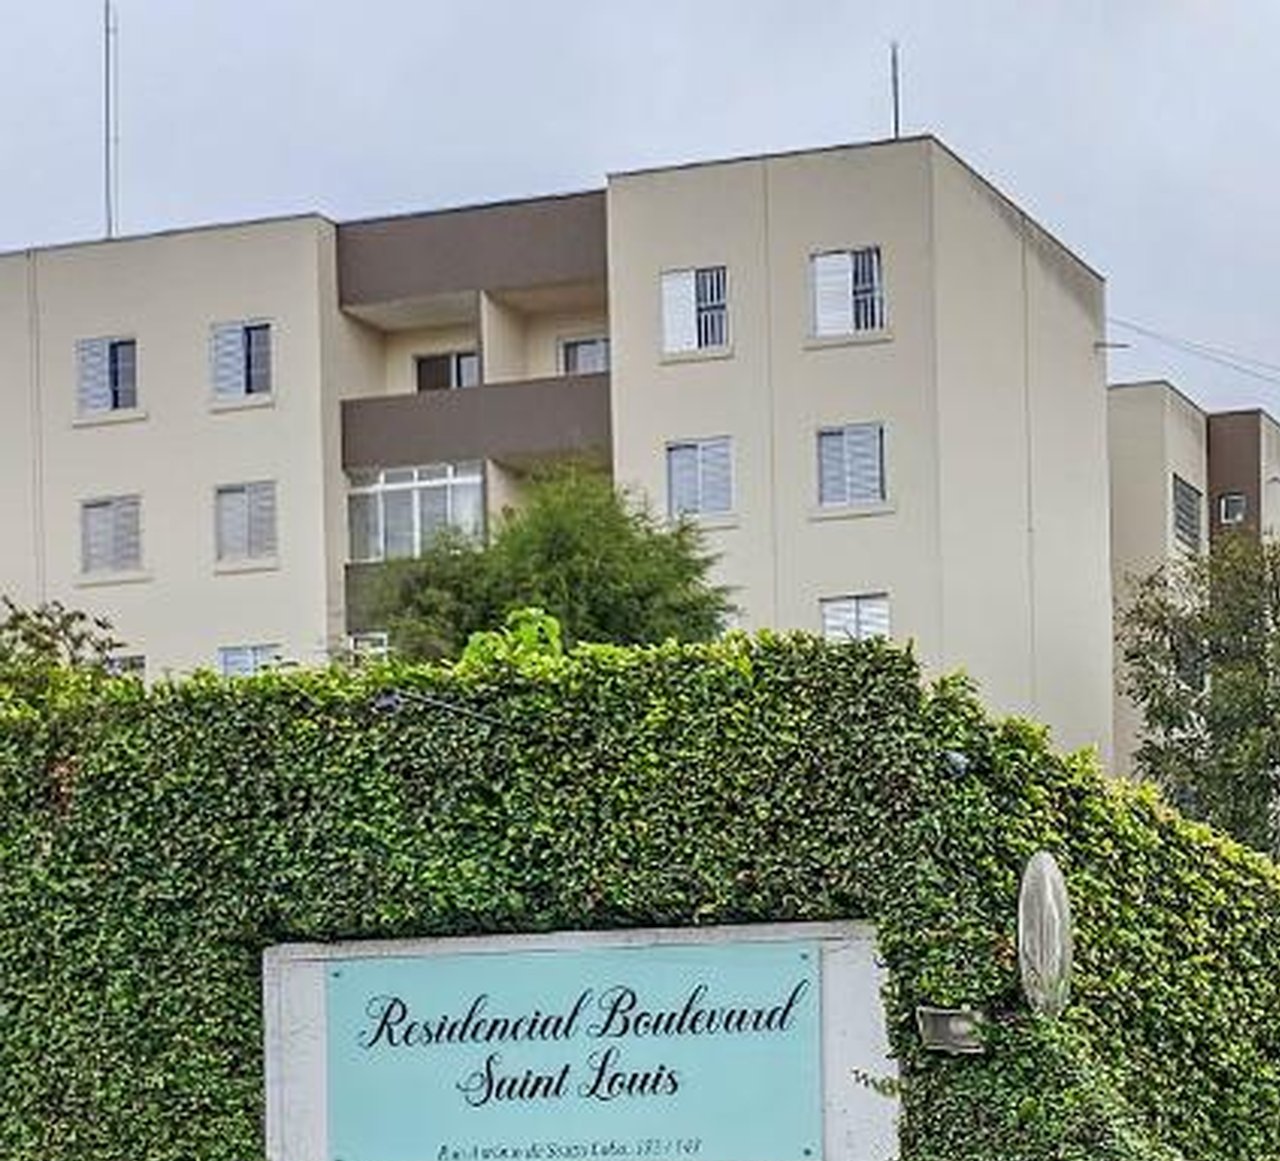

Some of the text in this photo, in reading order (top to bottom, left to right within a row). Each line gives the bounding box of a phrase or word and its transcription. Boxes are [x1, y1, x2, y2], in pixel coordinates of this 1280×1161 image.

[357, 979, 811, 1050] Residencial Boulevard
[455, 1046, 682, 1108] Saint Louis
